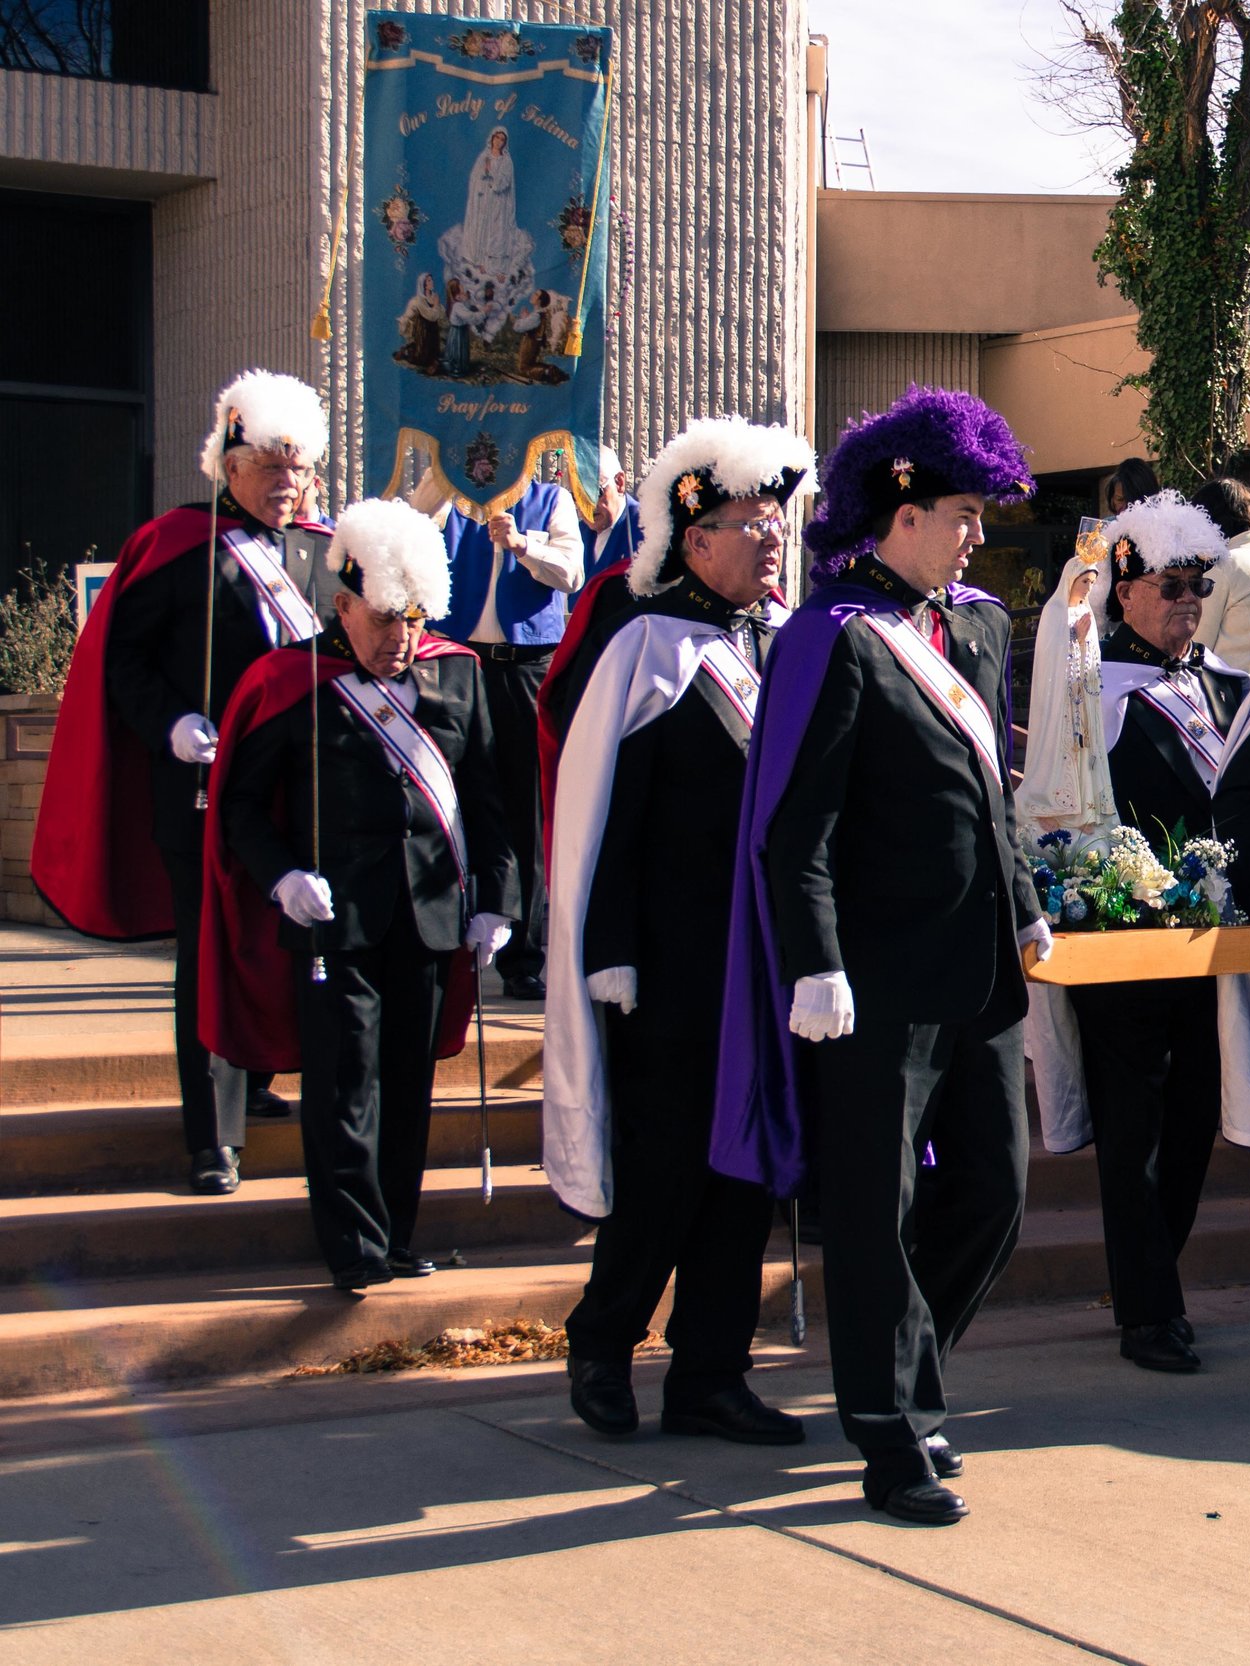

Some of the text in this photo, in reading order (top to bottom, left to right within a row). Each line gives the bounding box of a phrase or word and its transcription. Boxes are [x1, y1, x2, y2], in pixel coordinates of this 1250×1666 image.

[399, 111, 428, 138] Our
[436, 91, 486, 121] Lady
[494, 92, 518, 120] of
[437, 394, 531, 422] Pray for us
